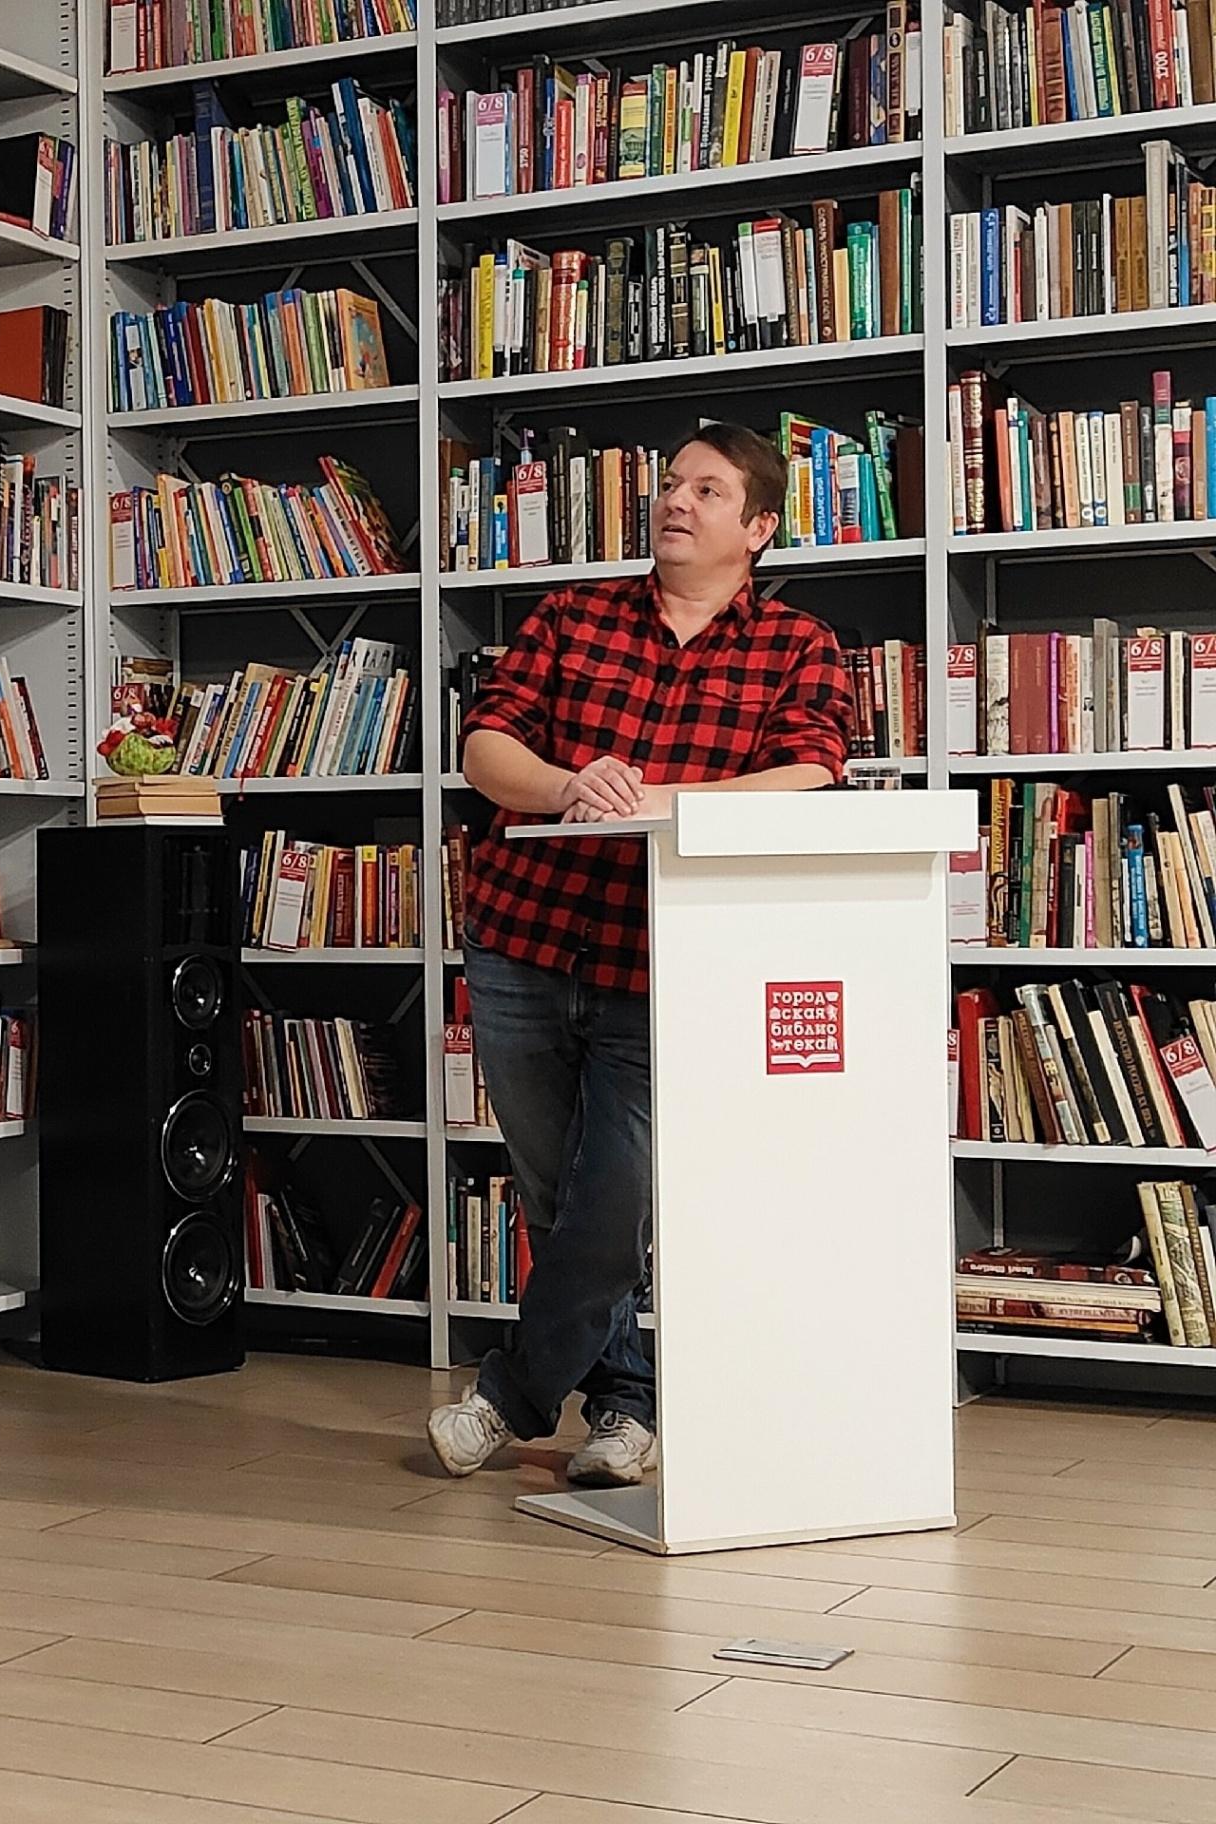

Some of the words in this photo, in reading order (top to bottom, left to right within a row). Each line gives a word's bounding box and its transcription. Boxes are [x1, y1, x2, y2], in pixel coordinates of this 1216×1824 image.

[806, 47, 834, 62] 6/8
[477, 95, 504, 112] 6/8
[519, 147, 530, 168] 1750
[817, 207, 827, 241] СЛОВАРЬ
[822, 299, 832, 322] СЛОВ
[813, 442, 824, 471] ЯЗЫК
[519, 466, 543, 482] 6/8
[112, 495, 132, 510] 6/8
[815, 477, 827, 536] ИСПАНСКИЙ
[948, 647, 975, 664] 6/8
[1130, 640, 1162, 657] 6/8
[282, 850, 307, 869] 6/8
[772, 991, 825, 1006] город
[782, 1006, 826, 1020] ская
[445, 1025, 470, 1042] 6/8
[770, 1021, 837, 1036] библио
[783, 1038, 826, 1052] тека
[1164, 1040, 1195, 1063] 6/8
